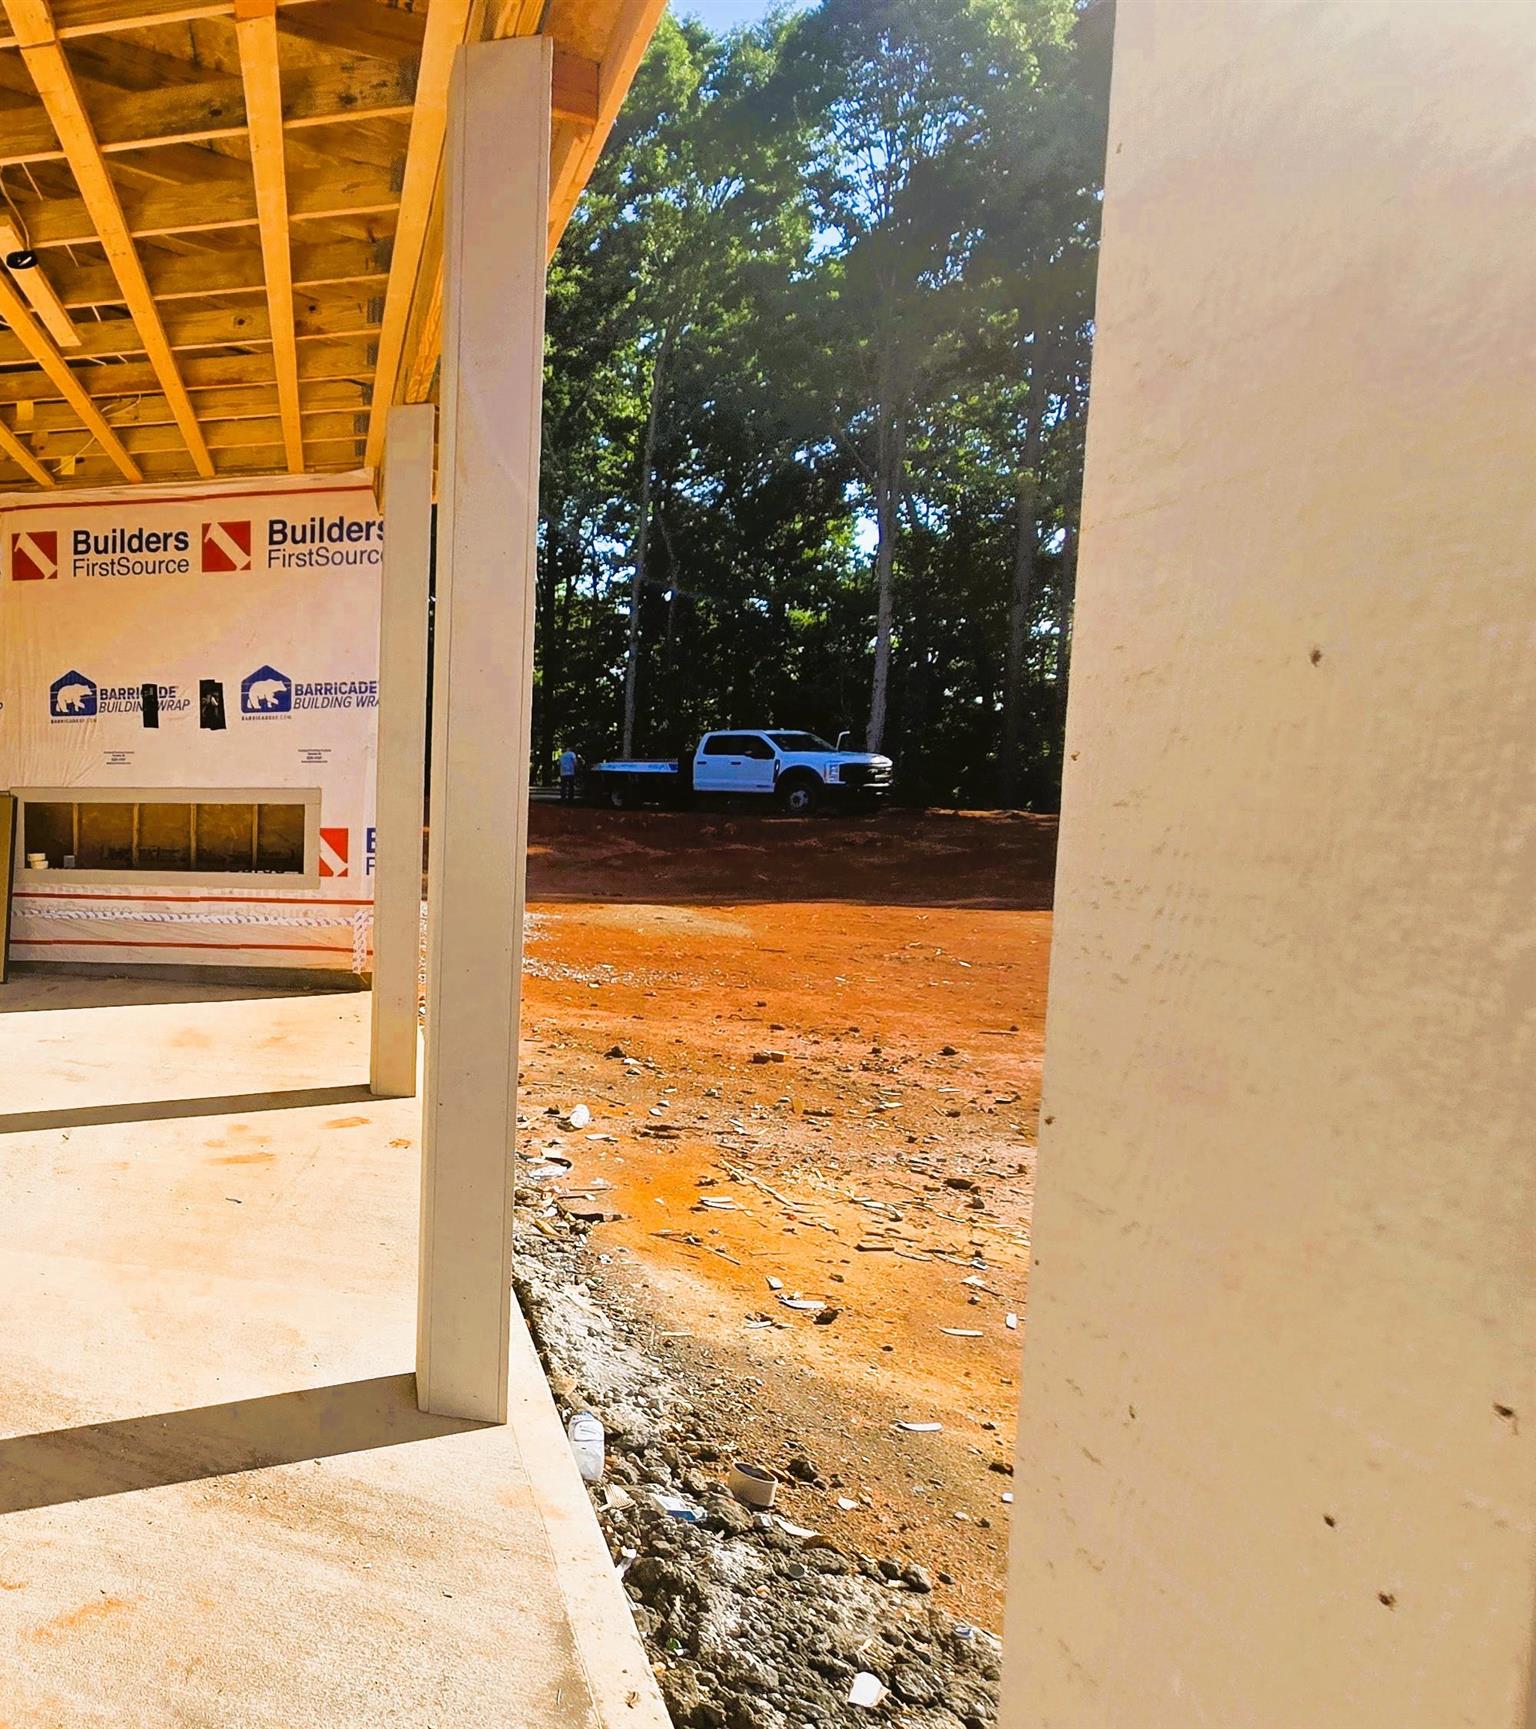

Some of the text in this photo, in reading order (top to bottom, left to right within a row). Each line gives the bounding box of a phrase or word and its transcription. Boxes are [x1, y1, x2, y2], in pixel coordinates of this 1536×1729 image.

[73, 527, 189, 555] Builders
[268, 546, 383, 568] FirstSourc
[73, 556, 190, 577] FirstSource
[100, 686, 177, 701] BARRIDE
[294, 681, 377, 697] BARRICADE
[99, 700, 144, 714] BUILDIN
[293, 696, 352, 710] BUILDING
